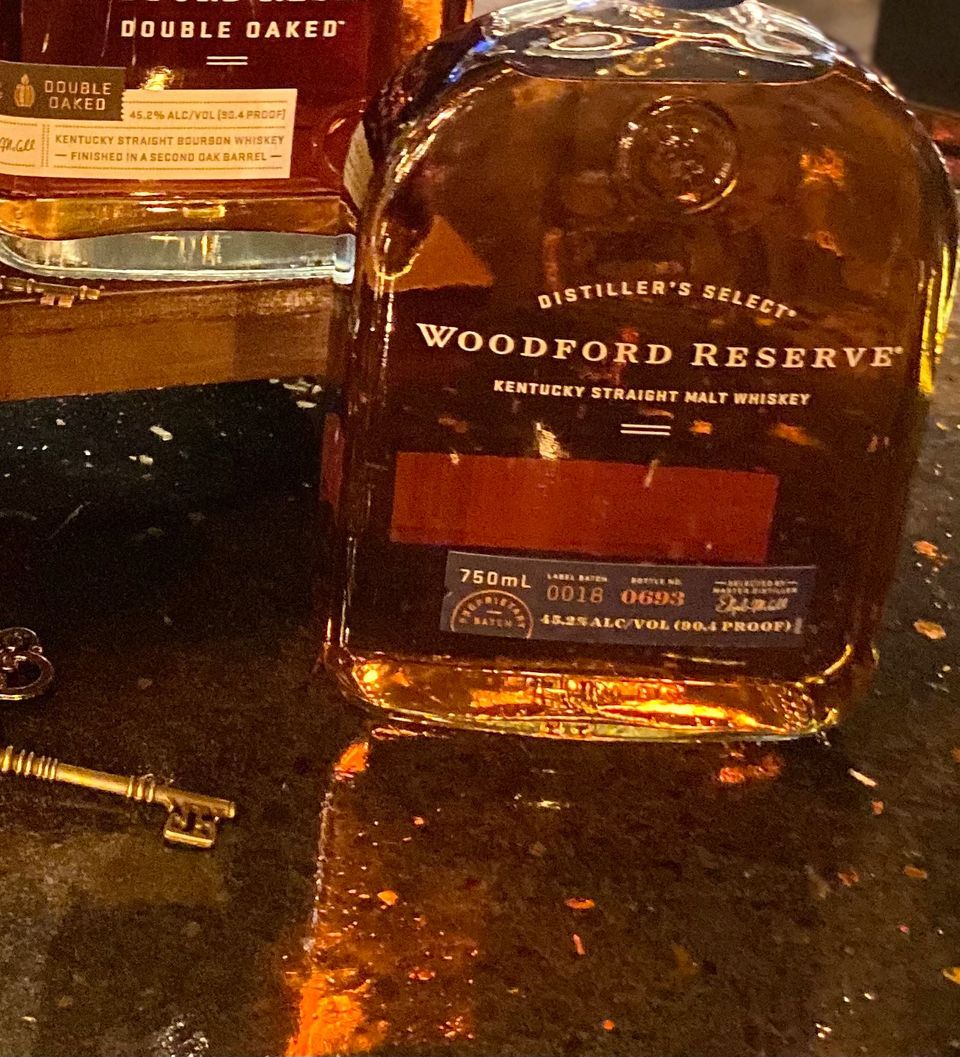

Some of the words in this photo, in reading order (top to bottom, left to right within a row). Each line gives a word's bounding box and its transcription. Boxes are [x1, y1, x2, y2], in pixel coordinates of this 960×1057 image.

[120, 19, 232, 39] DOUBLE
[244, 19, 340, 39] OAKED
[44, 79, 112, 95] DOUBLE
[49, 97, 106, 111] OAKED
[129, 109, 166, 121] 45.2%
[167, 109, 215, 121] ALC/VOL
[54, 134, 114, 146] KENTUCKY
[117, 134, 174, 147] STRAIGHT
[176, 135, 231, 146] BOURBON
[234, 135, 286, 147] WHISKEY
[70, 151, 124, 162] FINISHED
[126, 151, 138, 162] IN
[139, 151, 148, 162] A
[149, 151, 196, 162] SECOND
[198, 151, 220, 162] OAK
[222, 151, 268, 162] BARREL
[538, 280, 692, 310] DISTILLER'S
[702, 284, 791, 320] SELECT
[416, 322, 673, 365] WOODFORD
[691, 341, 896, 369] RESERVE
[493, 379, 585, 399] KENTUCKY
[590, 385, 679, 404] STRAIGHT
[684, 390, 729, 405] MALT
[732, 391, 812, 407] WHISKEY
[459, 568, 532, 589] 750mL
[546, 584, 604, 605] 0018
[620, 588, 686, 607] 0693
[472, 617, 513, 629] BATCH
[589, 616, 671, 632] ALC/VOL
[720, 618, 793, 634] PROOF)
